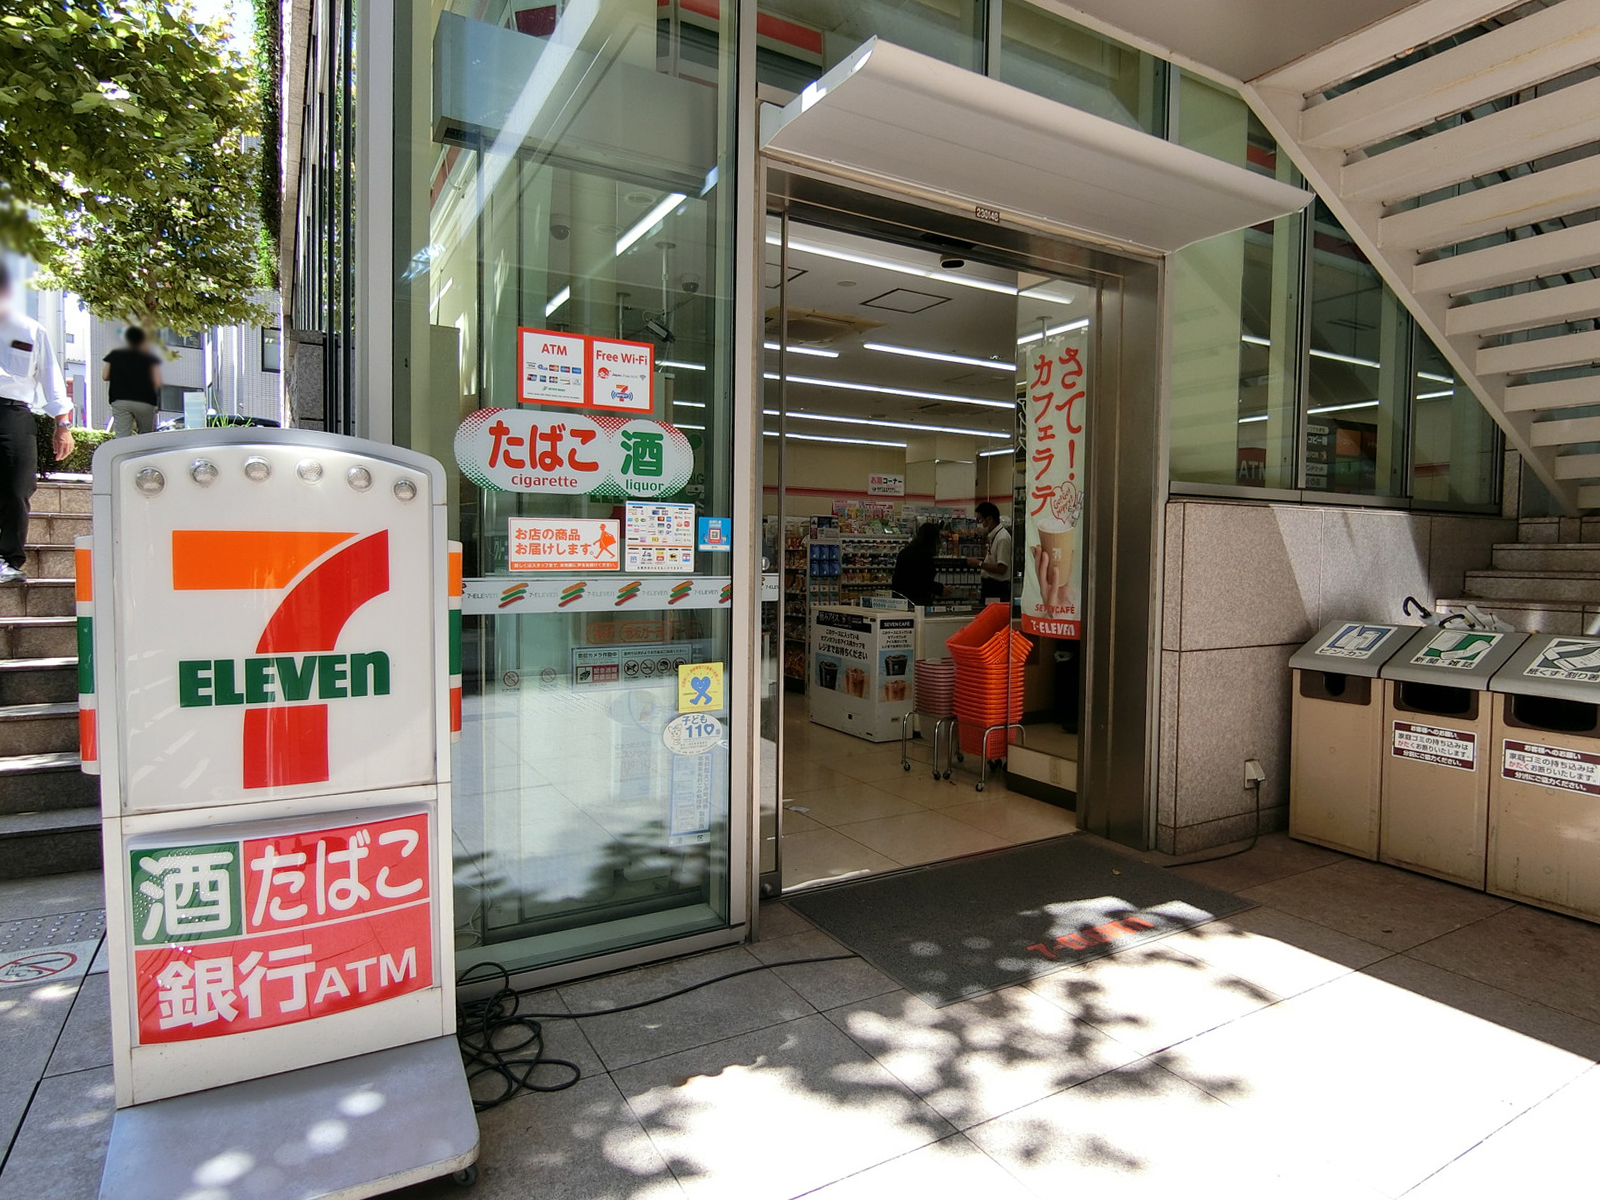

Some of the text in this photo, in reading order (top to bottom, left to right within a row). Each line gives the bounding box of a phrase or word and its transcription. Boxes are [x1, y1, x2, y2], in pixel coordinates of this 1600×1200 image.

[541, 343, 568, 356] ATM
[596, 350, 648, 366] Free Wi-Fi
[1030, 354, 1056, 517] カフェラテ
[488, 420, 599, 472] たばこ
[620, 429, 664, 477] 酒
[511, 473, 578, 489] cigarette
[625, 478, 665, 493] liquor
[515, 528, 581, 541] お店の商品
[515, 543, 594, 556] お届けします。
[171, 528, 390, 789] 7
[818, 642, 868, 660] レジまでお持ちください
[682, 714, 708, 725] 子ども
[1398, 732, 1469, 751] 家庭ゴミの持ち込みは
[1398, 740, 1470, 759] かたくお断りいたします。
[1509, 752, 1595, 774] 家庭ゴミの持ち込みは
[1509, 760, 1597, 783] かたくお断りいたします。
[251, 829, 423, 927] たばこ
[139, 852, 234, 940] 酒
[156, 944, 417, 1030] 銀行ATM
